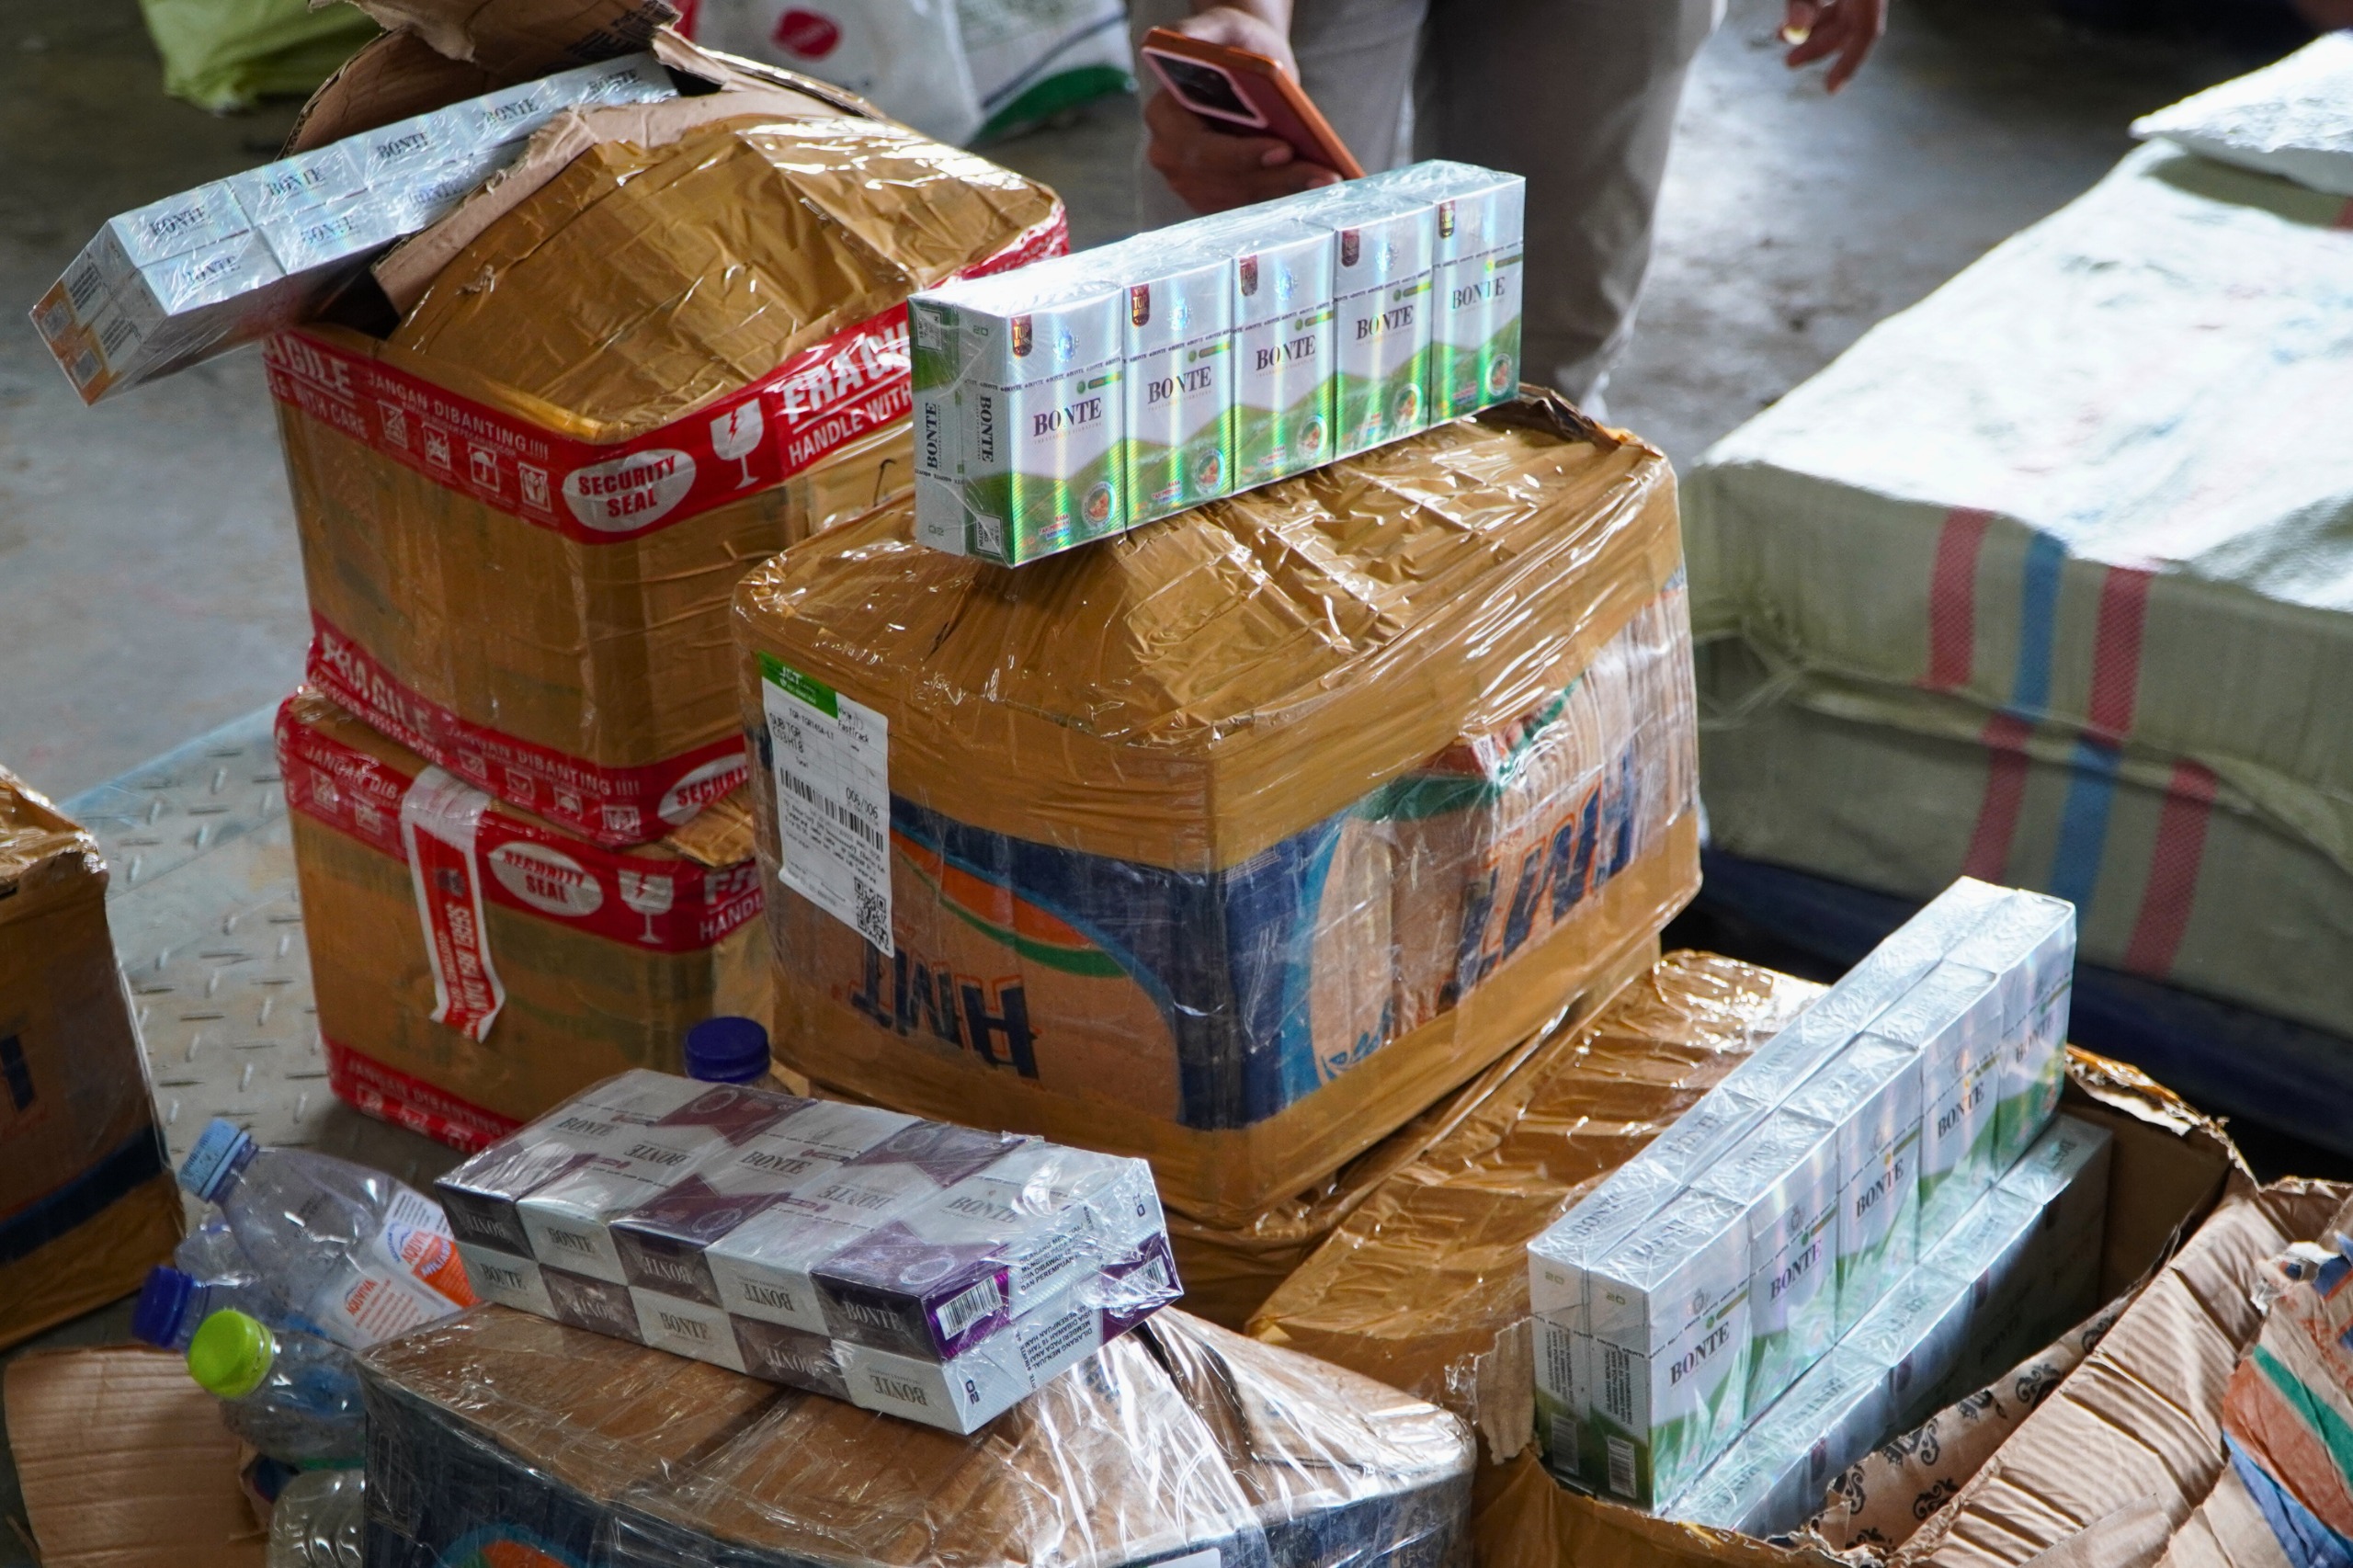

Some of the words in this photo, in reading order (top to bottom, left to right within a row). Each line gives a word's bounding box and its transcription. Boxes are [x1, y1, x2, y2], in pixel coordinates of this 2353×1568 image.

[377, 131, 434, 160] BONTE
[267, 166, 326, 198] BONTE
[149, 204, 210, 238] BONTE
[1132, 295, 1147, 310] TOP
[1452, 276, 1506, 310] BONTE
[1014, 325, 1029, 340] TOP
[1356, 304, 1415, 341] BONTE
[1256, 335, 1316, 371] BONTE
[1148, 366, 1212, 405] BONTE
[330, 402, 369, 439] CARE
[367, 372, 429, 409] JANGAN
[434, 398, 528, 452] DIBANTING
[789, 402, 865, 467] HANDLE
[867, 379, 913, 423] WITH
[1032, 396, 1103, 438] BONTE
[925, 402, 938, 471] BONTE
[980, 395, 995, 464] BONTE
[577, 455, 676, 496] SECURITY
[607, 486, 659, 518] SEAL
[517, 745, 611, 797] DIBANTING
[503, 849, 585, 889] SECURITY
[524, 874, 569, 904] SEAL
[1937, 1081, 1984, 1139] BONTE
[623, 1143, 692, 1167] BONTE
[740, 1151, 813, 1176] BONTE
[1855, 1159, 1904, 1220] BONTE
[547, 1228, 596, 1254] BONTE
[1021, 1278, 1036, 1291] DAN
[1036, 1256, 1075, 1283] PEREMPUAN
[1769, 1240, 1822, 1302] BONTE
[744, 1283, 795, 1312] BONTE
[659, 1312, 708, 1340] BONTE
[843, 1301, 902, 1332] BONTE
[1051, 1318, 1078, 1342] DIBAWAH
[1064, 1320, 1091, 1341] MEMBERI
[1077, 1309, 1094, 1323] USIA
[1045, 1335, 1065, 1352] PADA
[1062, 1326, 1094, 1352] DILARANG
[1669, 1322, 1731, 1387] BONTE
[1033, 1348, 1063, 1370] MENJUAL
[870, 1374, 929, 1407] BONTE
